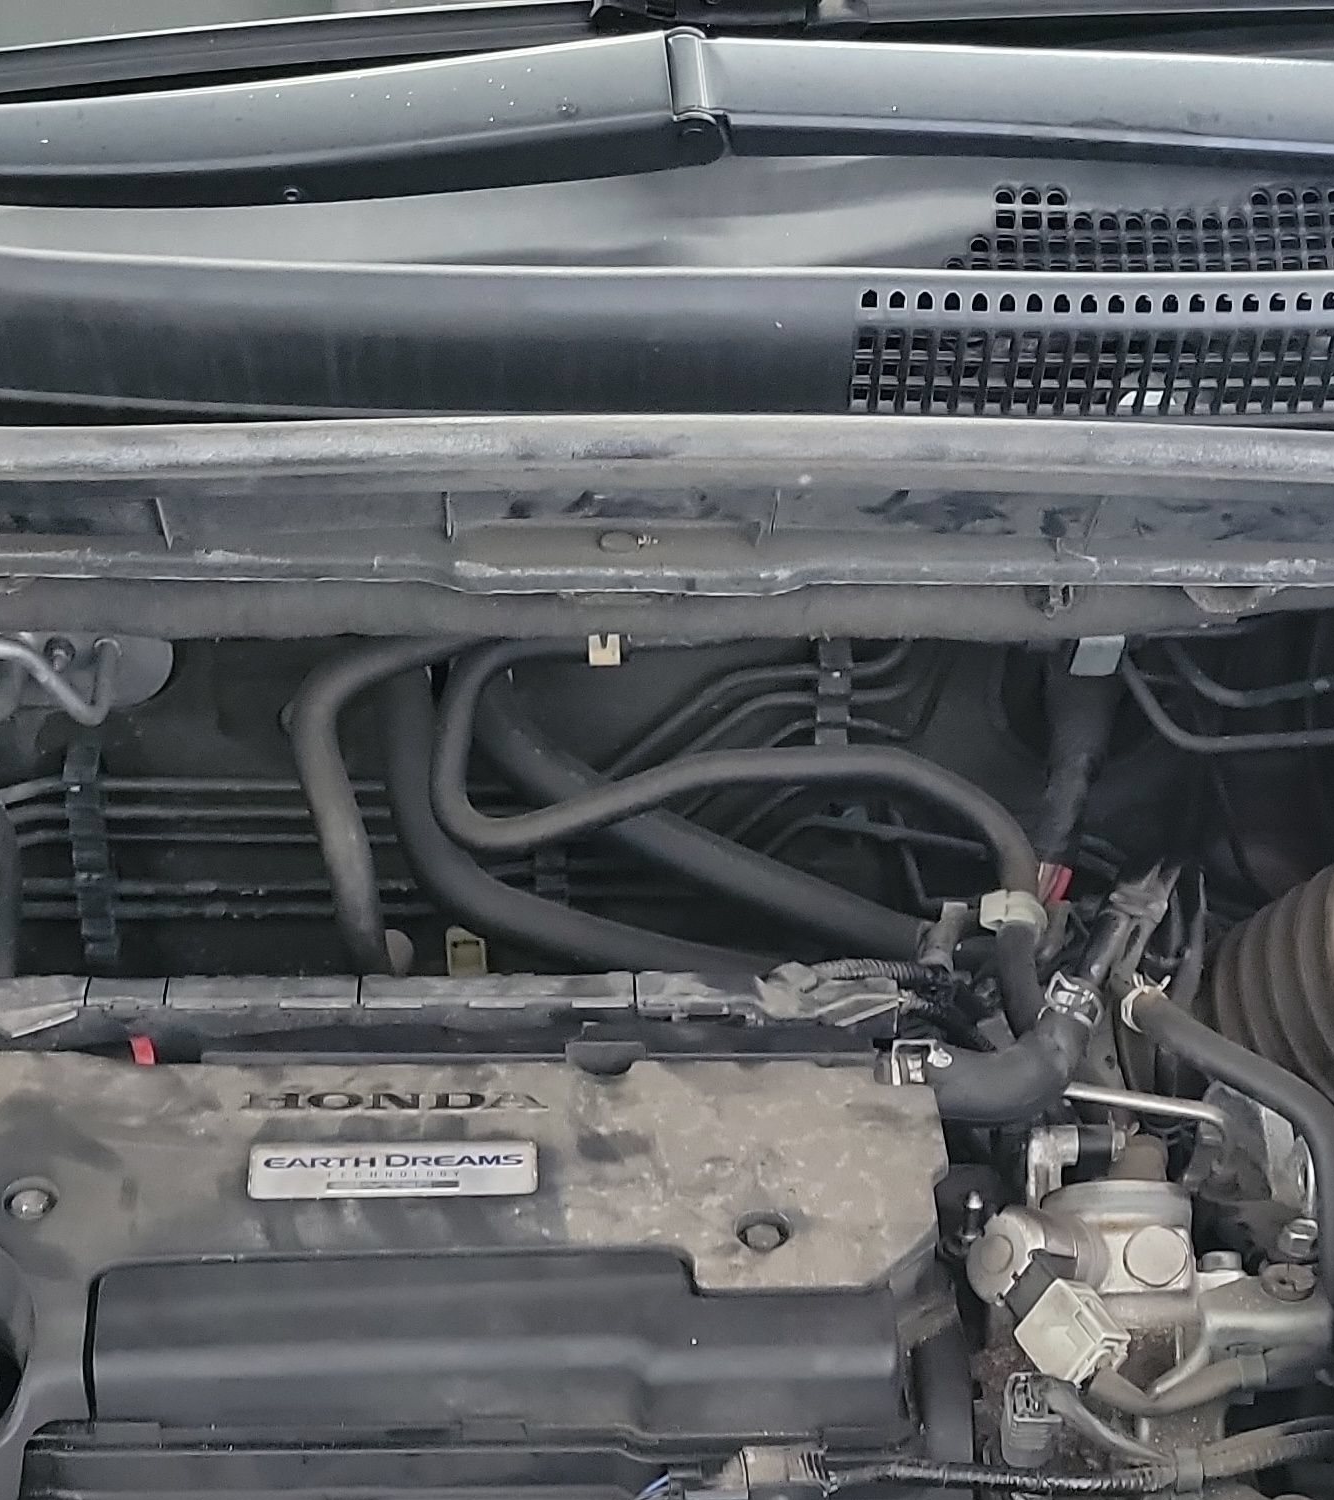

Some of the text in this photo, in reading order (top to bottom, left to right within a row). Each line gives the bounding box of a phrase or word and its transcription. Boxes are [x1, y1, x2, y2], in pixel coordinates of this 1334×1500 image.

[240, 1091, 549, 1112] HONDA
[263, 1153, 524, 1169] EARTH DREAMS
[326, 1171, 460, 1179] TECHNOLOGY
